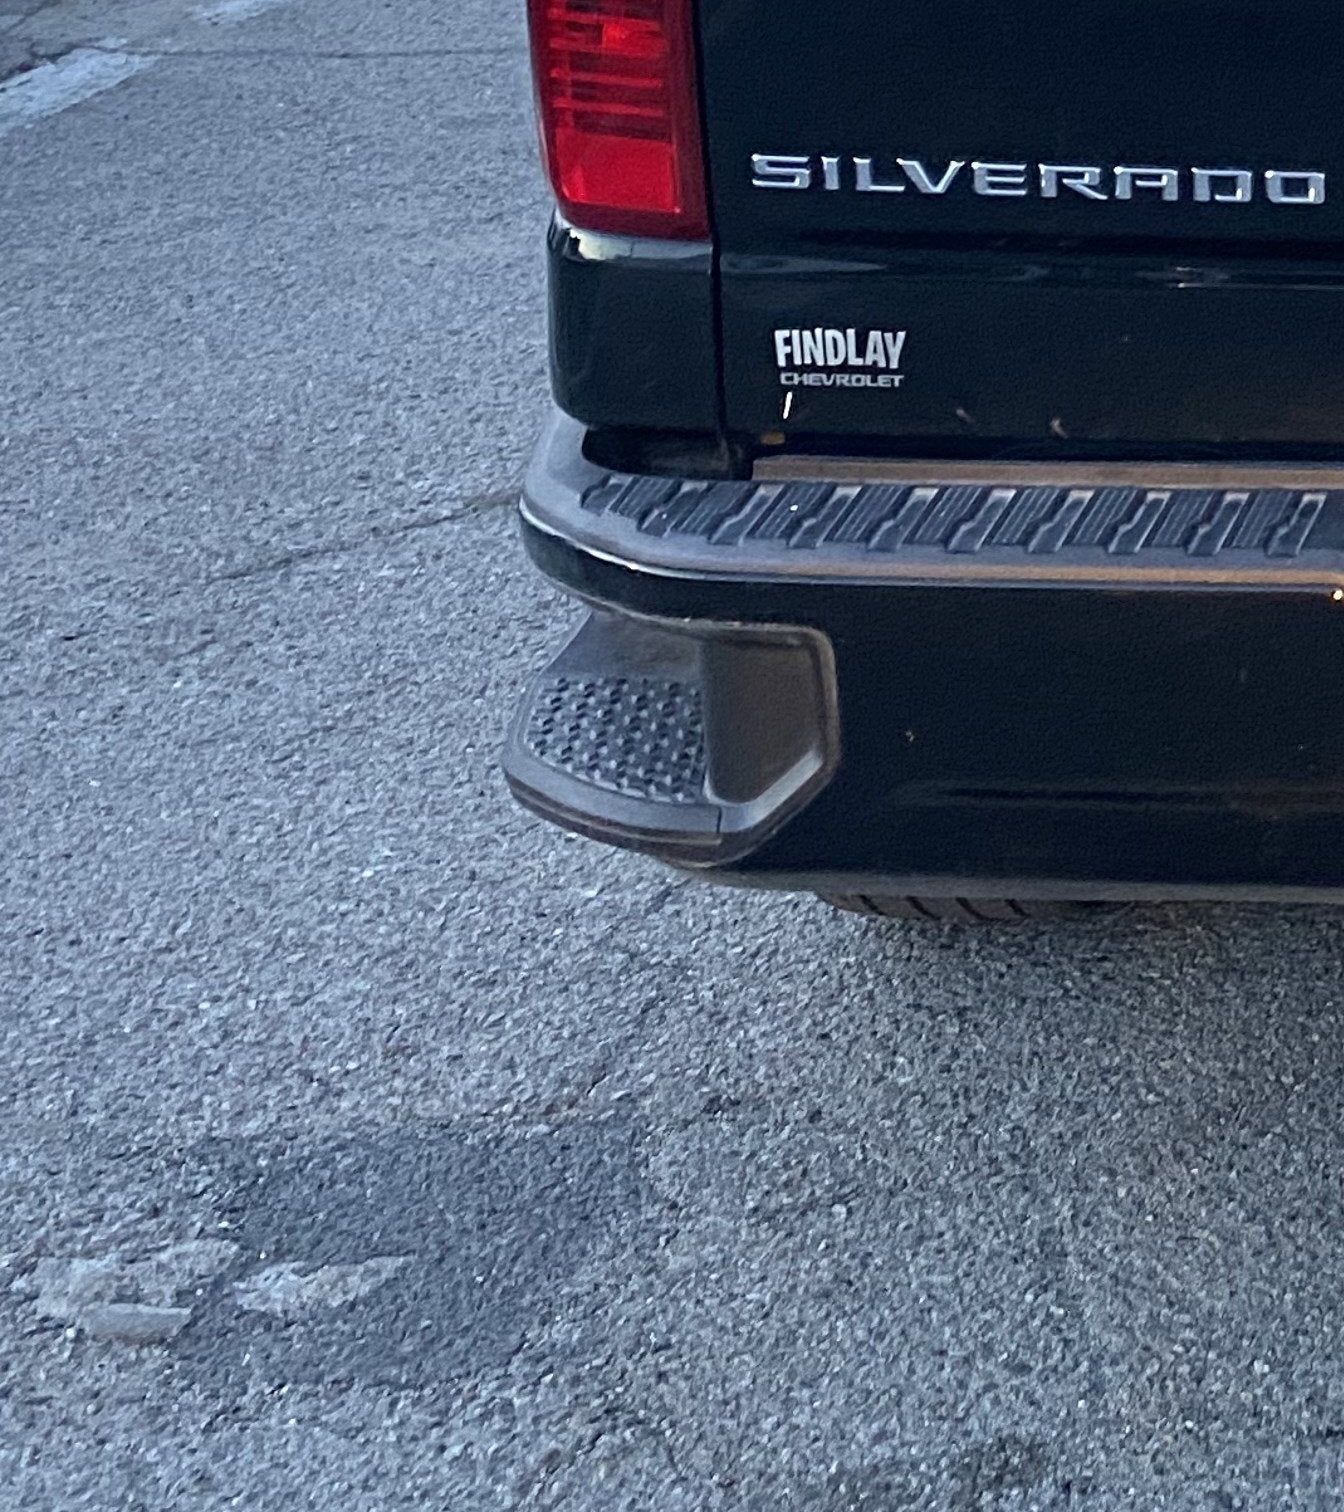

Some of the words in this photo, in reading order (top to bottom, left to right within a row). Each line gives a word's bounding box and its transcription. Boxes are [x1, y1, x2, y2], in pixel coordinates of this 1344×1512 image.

[751, 153, 1326, 205] SILVERADO
[774, 327, 906, 369] FINDLAY
[779, 372, 904, 388] CHEVROLET
